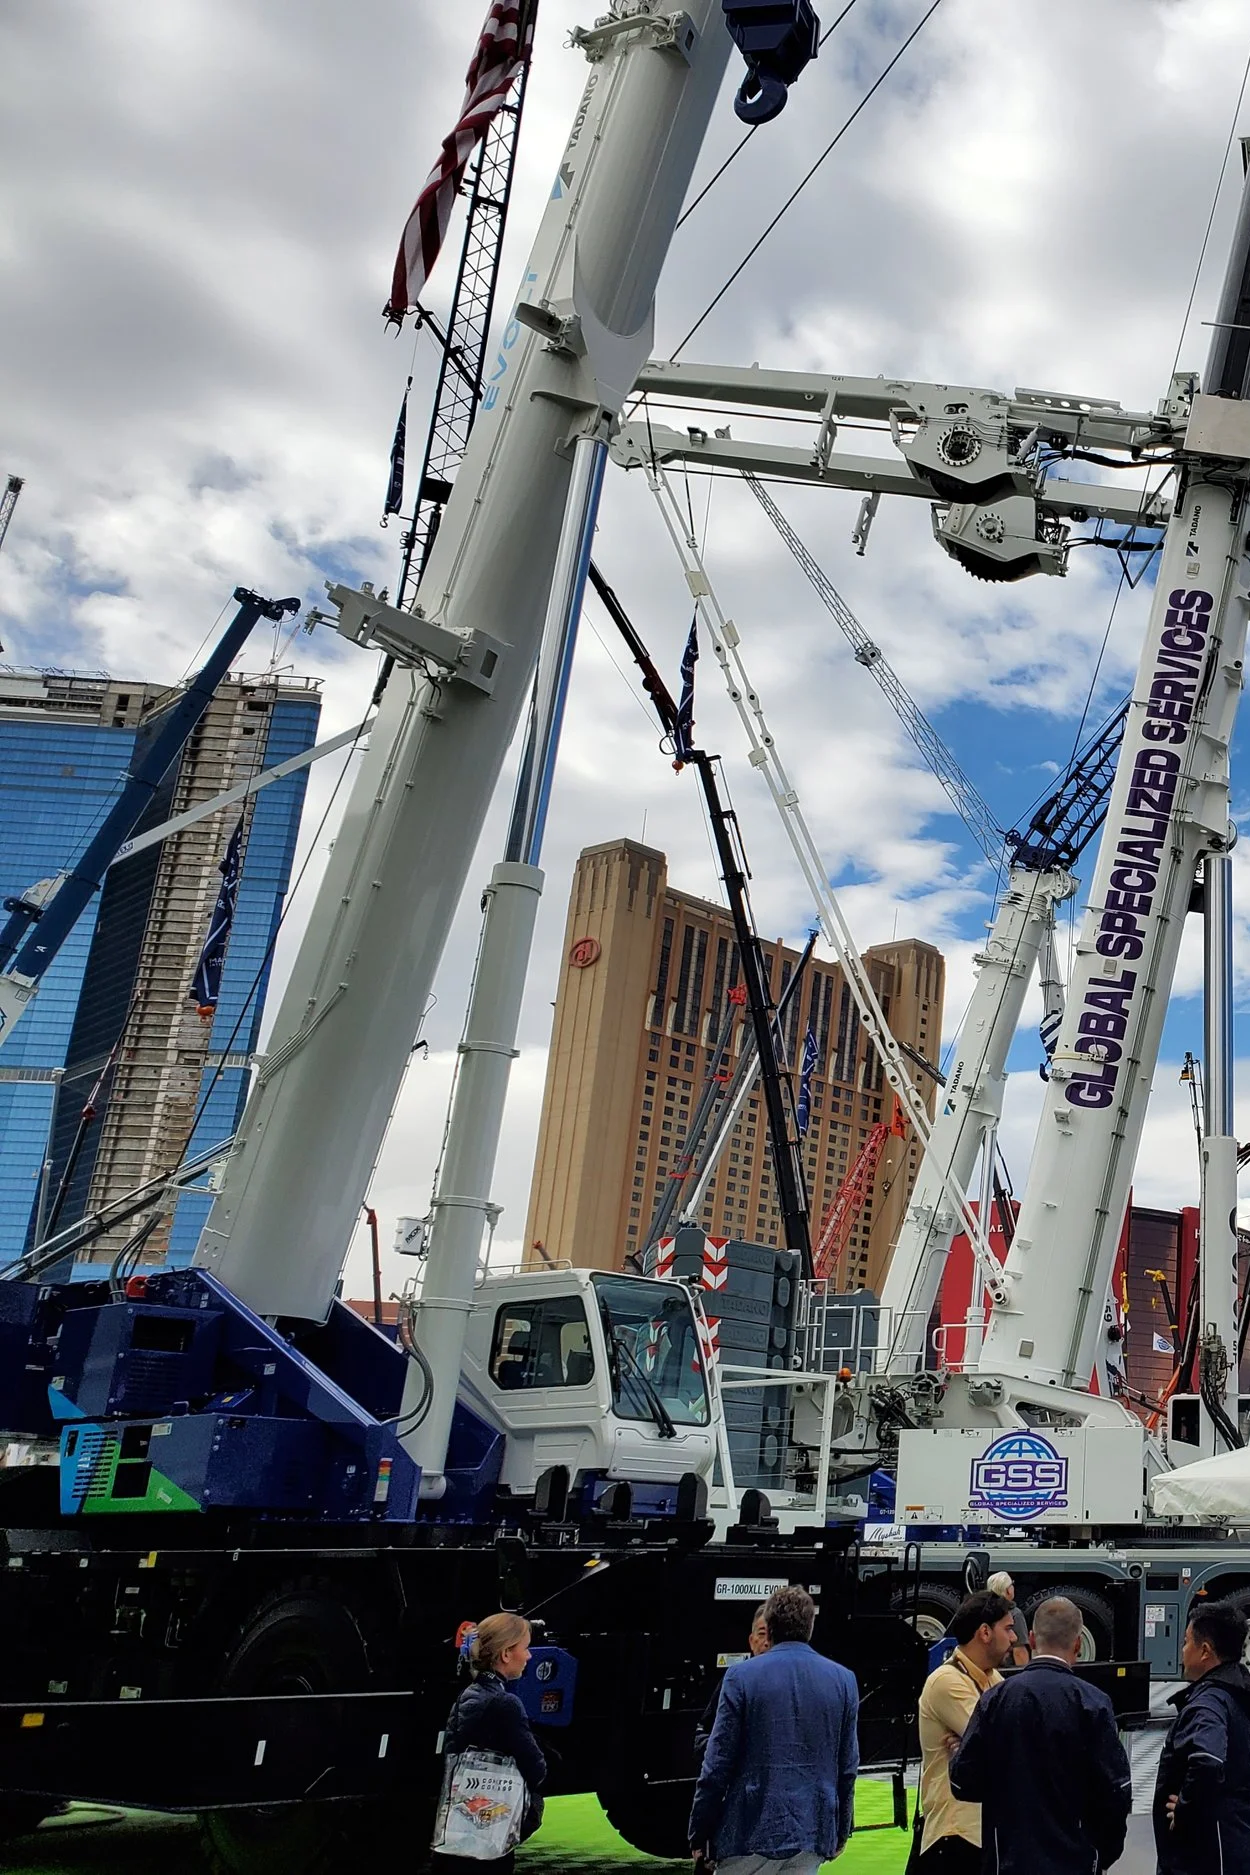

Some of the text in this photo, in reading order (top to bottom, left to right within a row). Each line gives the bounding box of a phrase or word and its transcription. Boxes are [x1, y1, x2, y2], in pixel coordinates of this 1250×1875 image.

[568, 74, 599, 151] TADANO
[481, 267, 538, 410] EVOT
[1189, 505, 1202, 537] TADANO
[1065, 589, 1214, 1109] GLOBAL SPECIALIZED SERVICES
[950, 1061, 965, 1094] TADANO
[721, 1296, 769, 1316] TADANO
[977, 1463, 1060, 1488] GSS
[716, 1583, 788, 1595] GR-1000XLL EVO
